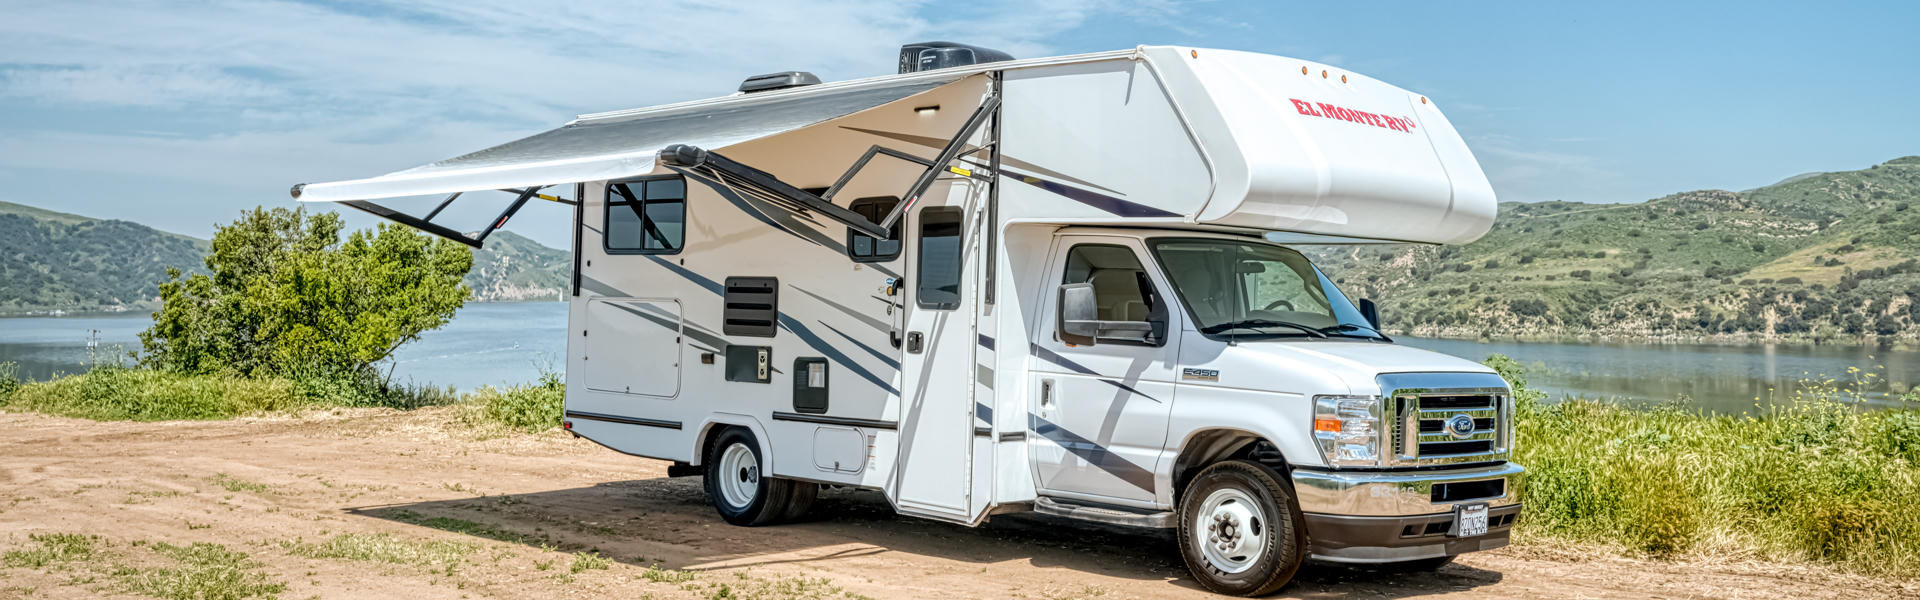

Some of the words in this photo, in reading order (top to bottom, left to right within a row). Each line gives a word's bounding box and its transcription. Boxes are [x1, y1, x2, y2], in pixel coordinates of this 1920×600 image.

[1289, 98, 1322, 117] EL
[1316, 101, 1387, 128] MONTE
[1380, 113, 1410, 133] RV
[1456, 419, 1471, 431] Ford
